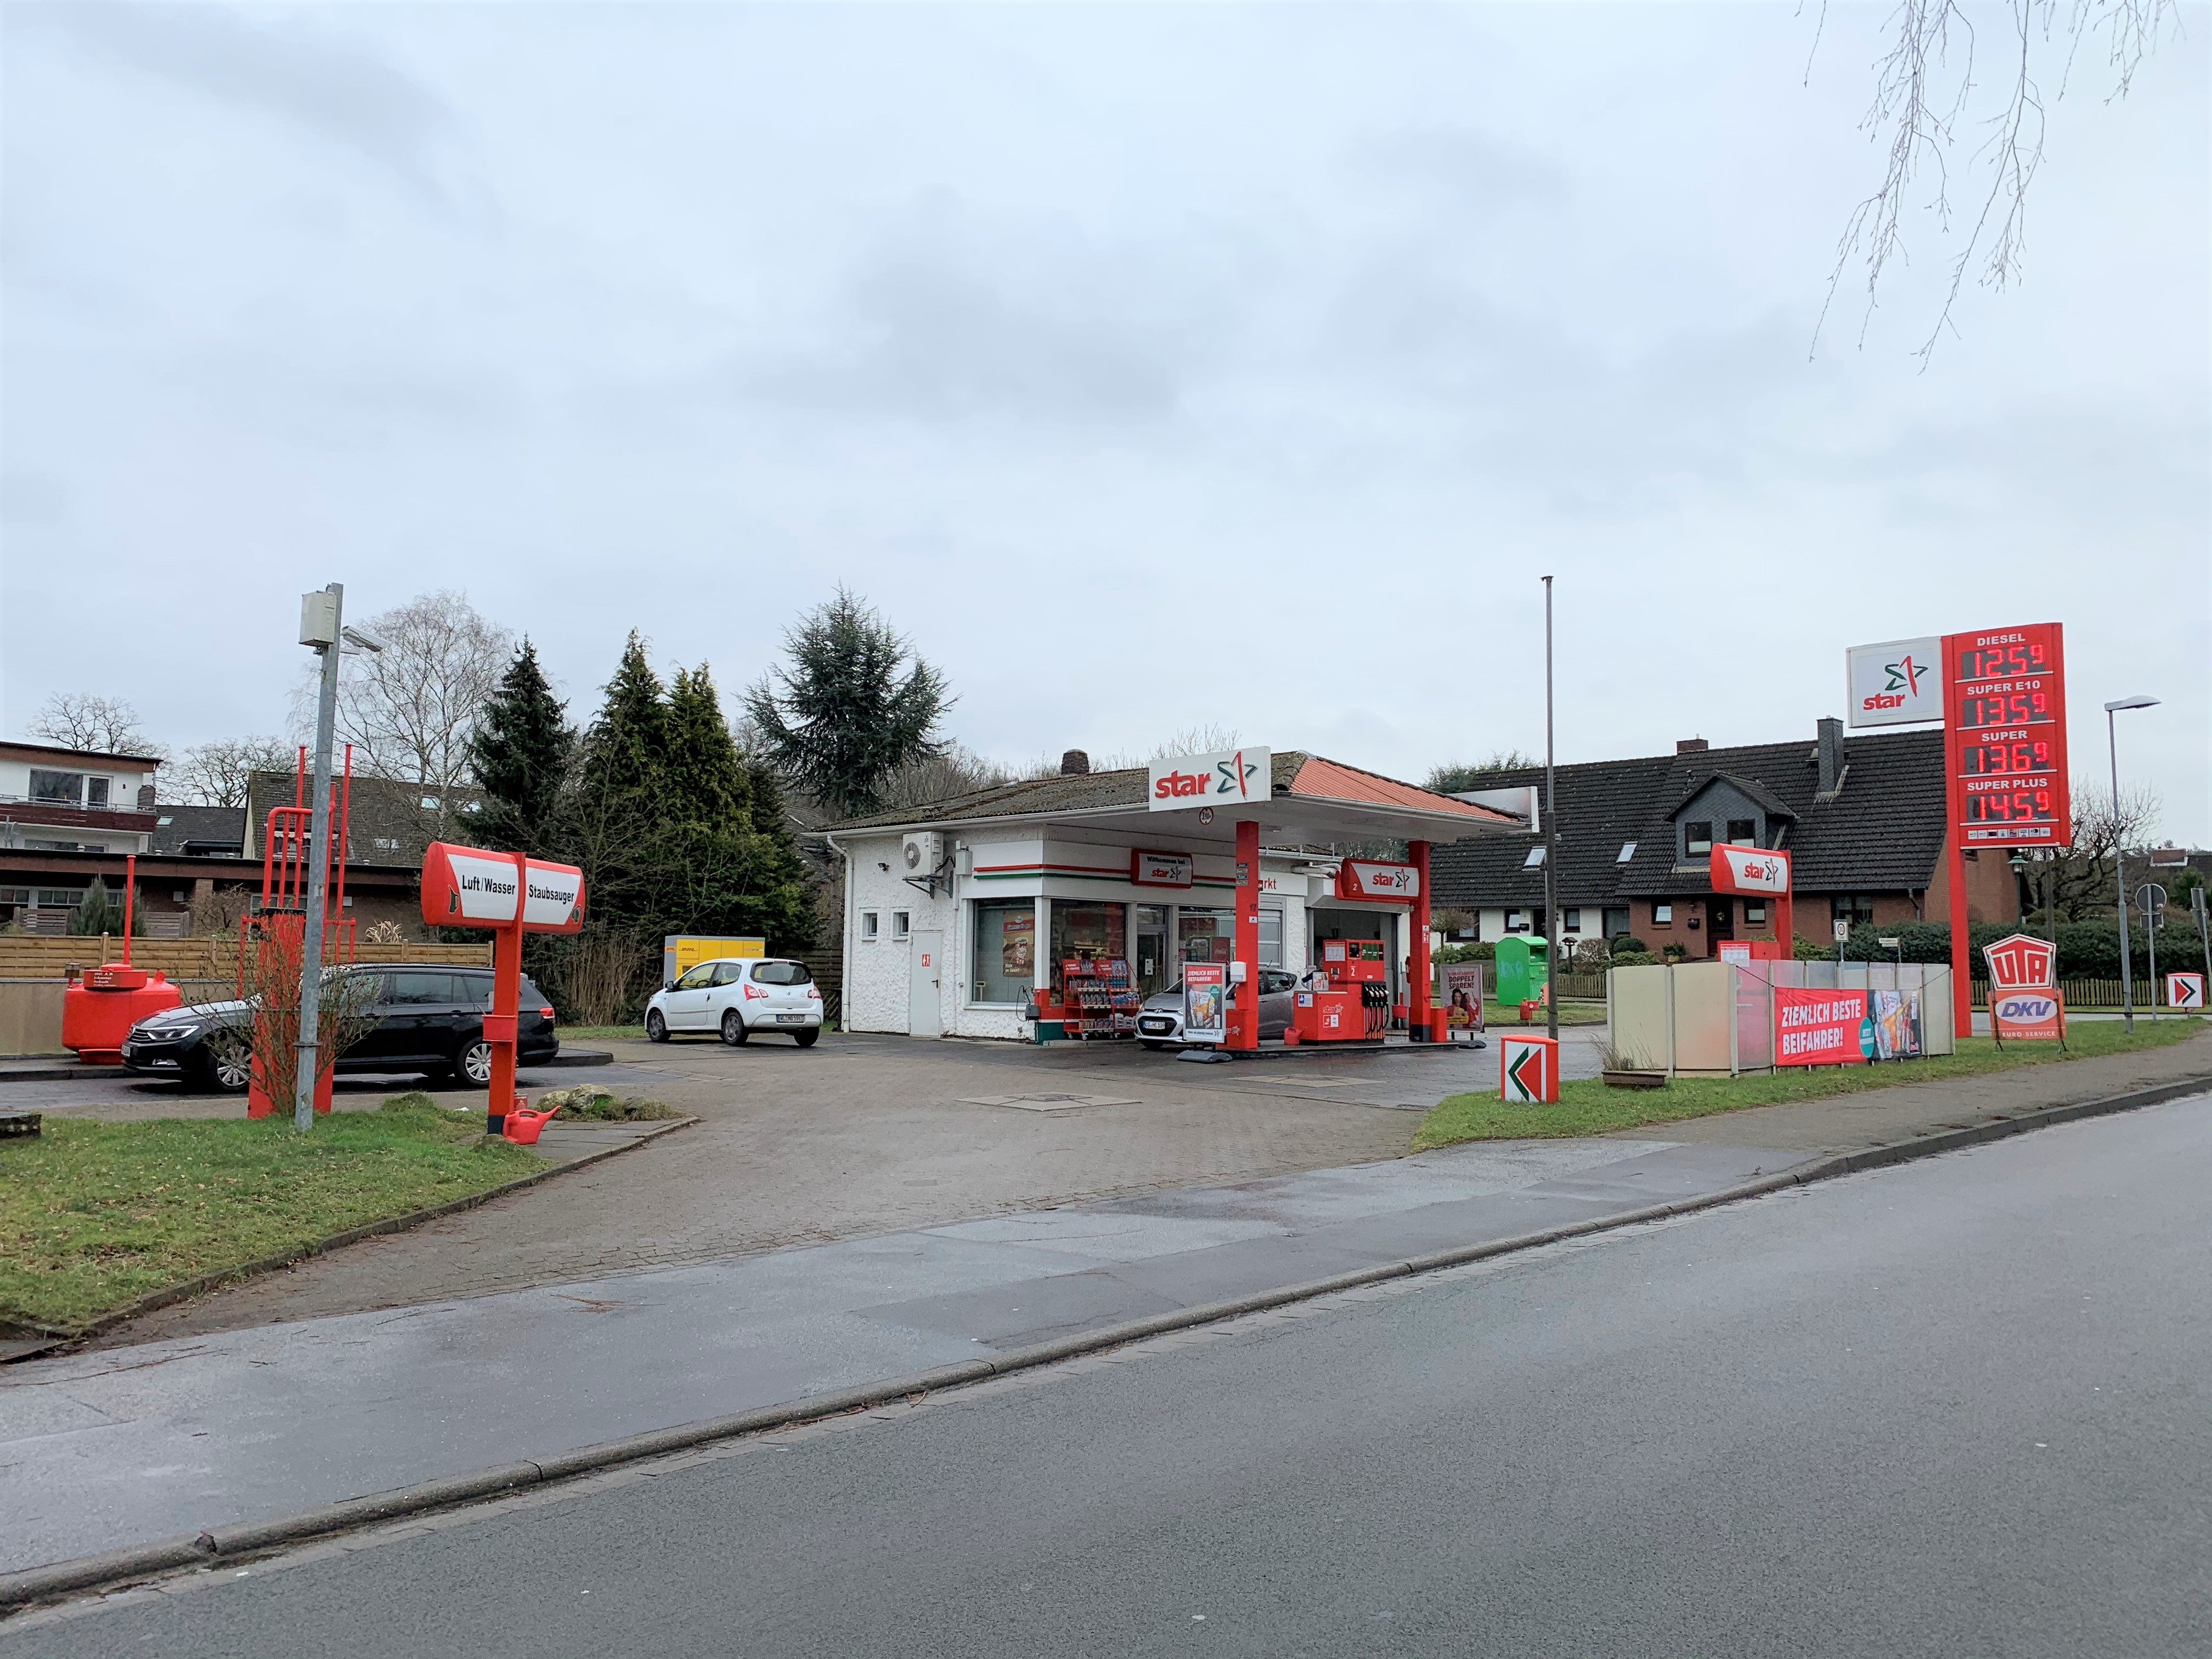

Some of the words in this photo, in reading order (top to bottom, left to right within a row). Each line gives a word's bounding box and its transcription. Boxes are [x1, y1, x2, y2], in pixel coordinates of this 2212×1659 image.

[1977, 633, 2026, 646] DIESEL
[1967, 682, 2012, 695] SUPER
[2016, 680, 2041, 691] E10
[1863, 692, 1905, 710] star
[1982, 730, 2028, 742] SUPER
[1155, 770, 1211, 799] star
[1967, 780, 2010, 791] SUPER
[2013, 778, 2048, 788] PLUS
[1146, 856, 1177, 864] Willkommen
[1151, 867, 1169, 878] star
[1744, 861, 1764, 879] star
[462, 874, 515, 895] Luft/Wasser
[1352, 883, 1358, 891] 2
[1372, 872, 1395, 887] star
[528, 884, 574, 905] Staubsauger
[1990, 940, 2050, 985] UTA
[1351, 967, 1355, 977] 2
[1323, 1006, 1335, 1014] star
[1781, 1002, 1830, 1028] ZIEMLICH
[1832, 998, 1861, 1022] BESTE
[2001, 1001, 2052, 1017] DKV
[1783, 1026, 1844, 1055] BEIFAHRER!
